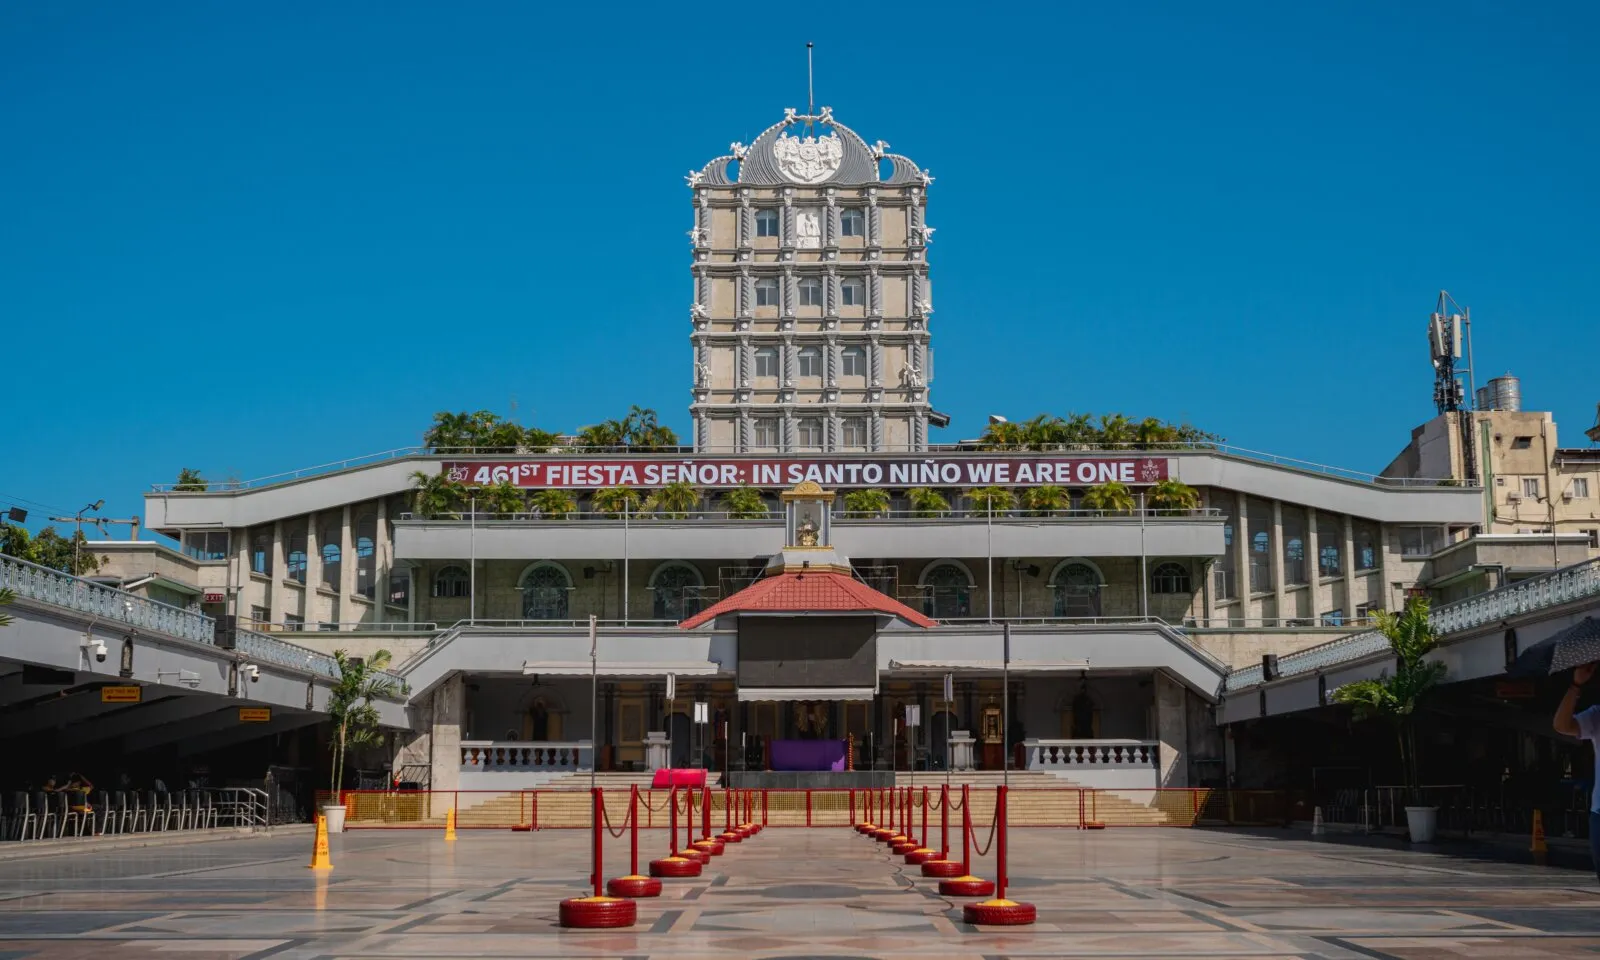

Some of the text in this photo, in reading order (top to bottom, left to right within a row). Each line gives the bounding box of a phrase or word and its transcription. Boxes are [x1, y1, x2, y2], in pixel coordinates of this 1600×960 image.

[474, 459, 1136, 485] 461ST FIESTA SEÑOR: IN SANTO NIÑO WE ARE ONE
